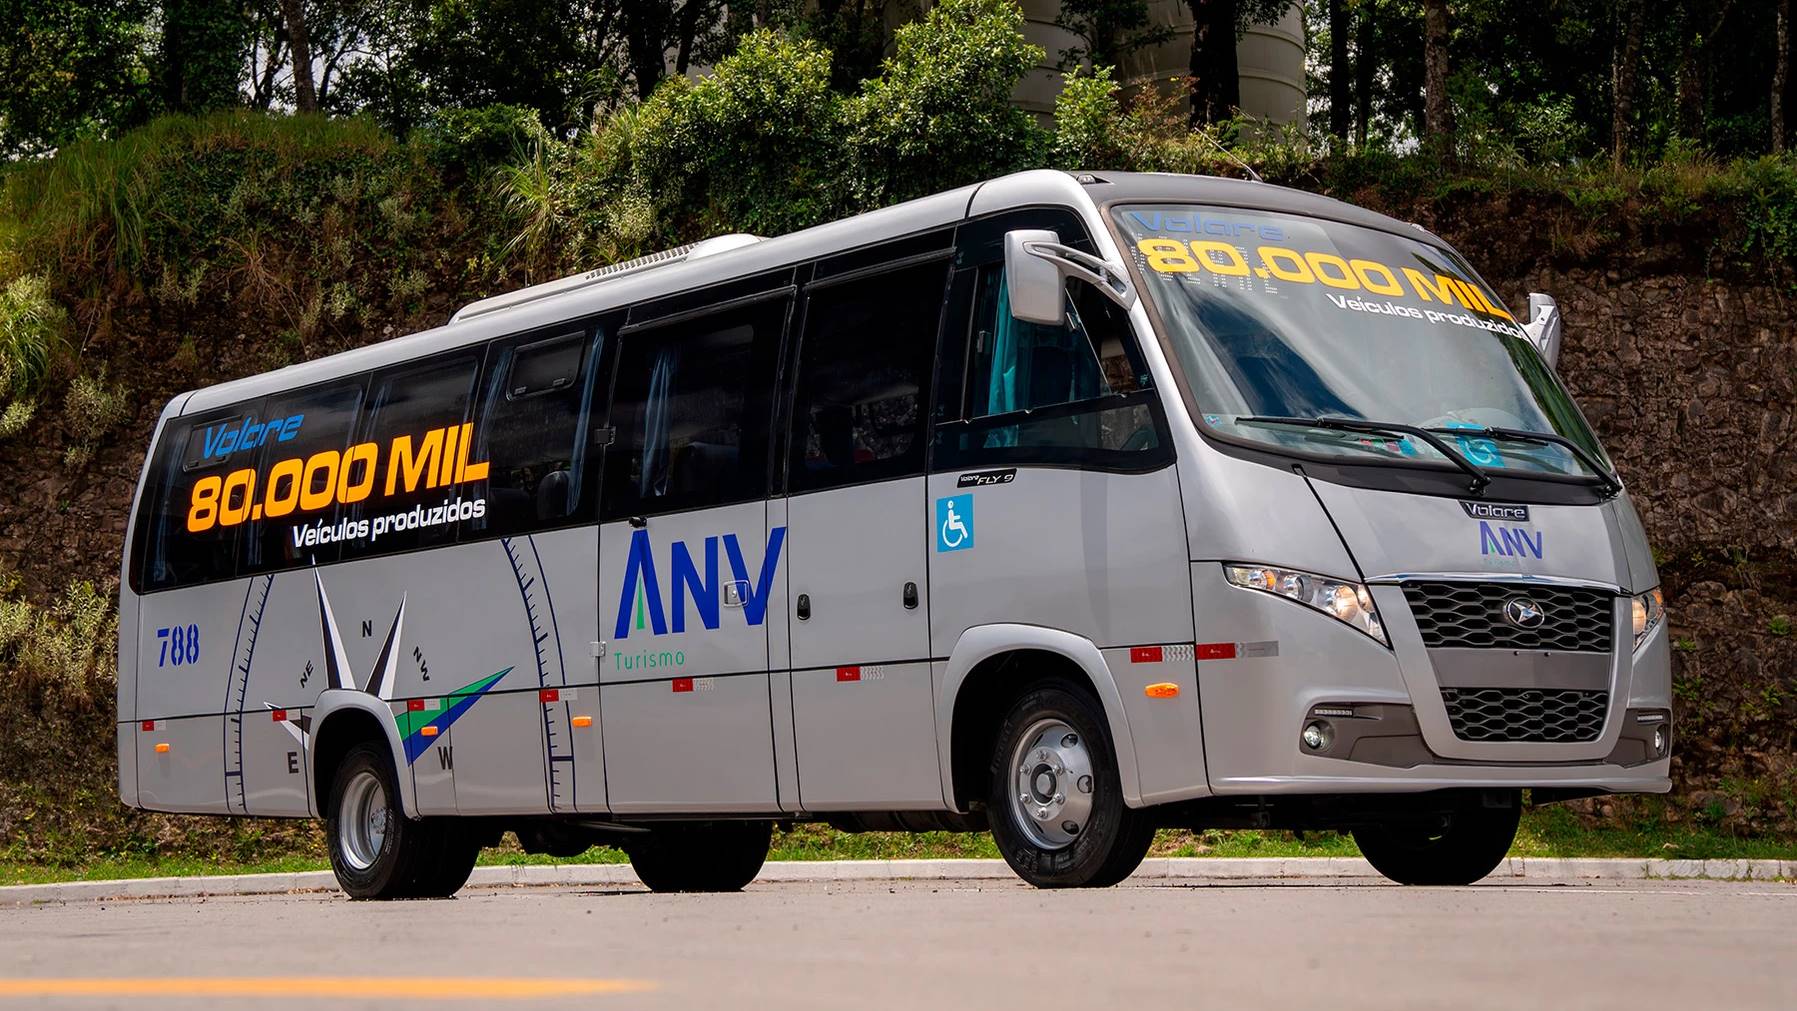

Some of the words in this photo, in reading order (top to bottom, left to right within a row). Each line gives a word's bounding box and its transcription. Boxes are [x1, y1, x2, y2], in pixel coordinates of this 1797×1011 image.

[1130, 211, 1284, 241] Volare
[1137, 238, 1404, 297] 80.000
[1401, 266, 1514, 322] MIL
[1326, 293, 1423, 319] Veículos
[203, 414, 304, 459] Volare
[187, 442, 378, 533] 80.000
[384, 422, 490, 496] MIL
[977, 475, 1001, 485] FLY
[1004, 474, 1014, 482] 9
[292, 518, 369, 549] Veículos
[372, 497, 486, 541] produzidos
[1465, 502, 1526, 519] Volare
[1479, 520, 1542, 560] ANV
[613, 527, 787, 639] ANV
[361, 620, 373, 637] N
[157, 623, 200, 667] 788
[613, 649, 685, 671] Turismo
[300, 660, 313, 688] NE
[413, 646, 430, 682] NW
[287, 751, 299, 774] E
[437, 746, 453, 770] W
